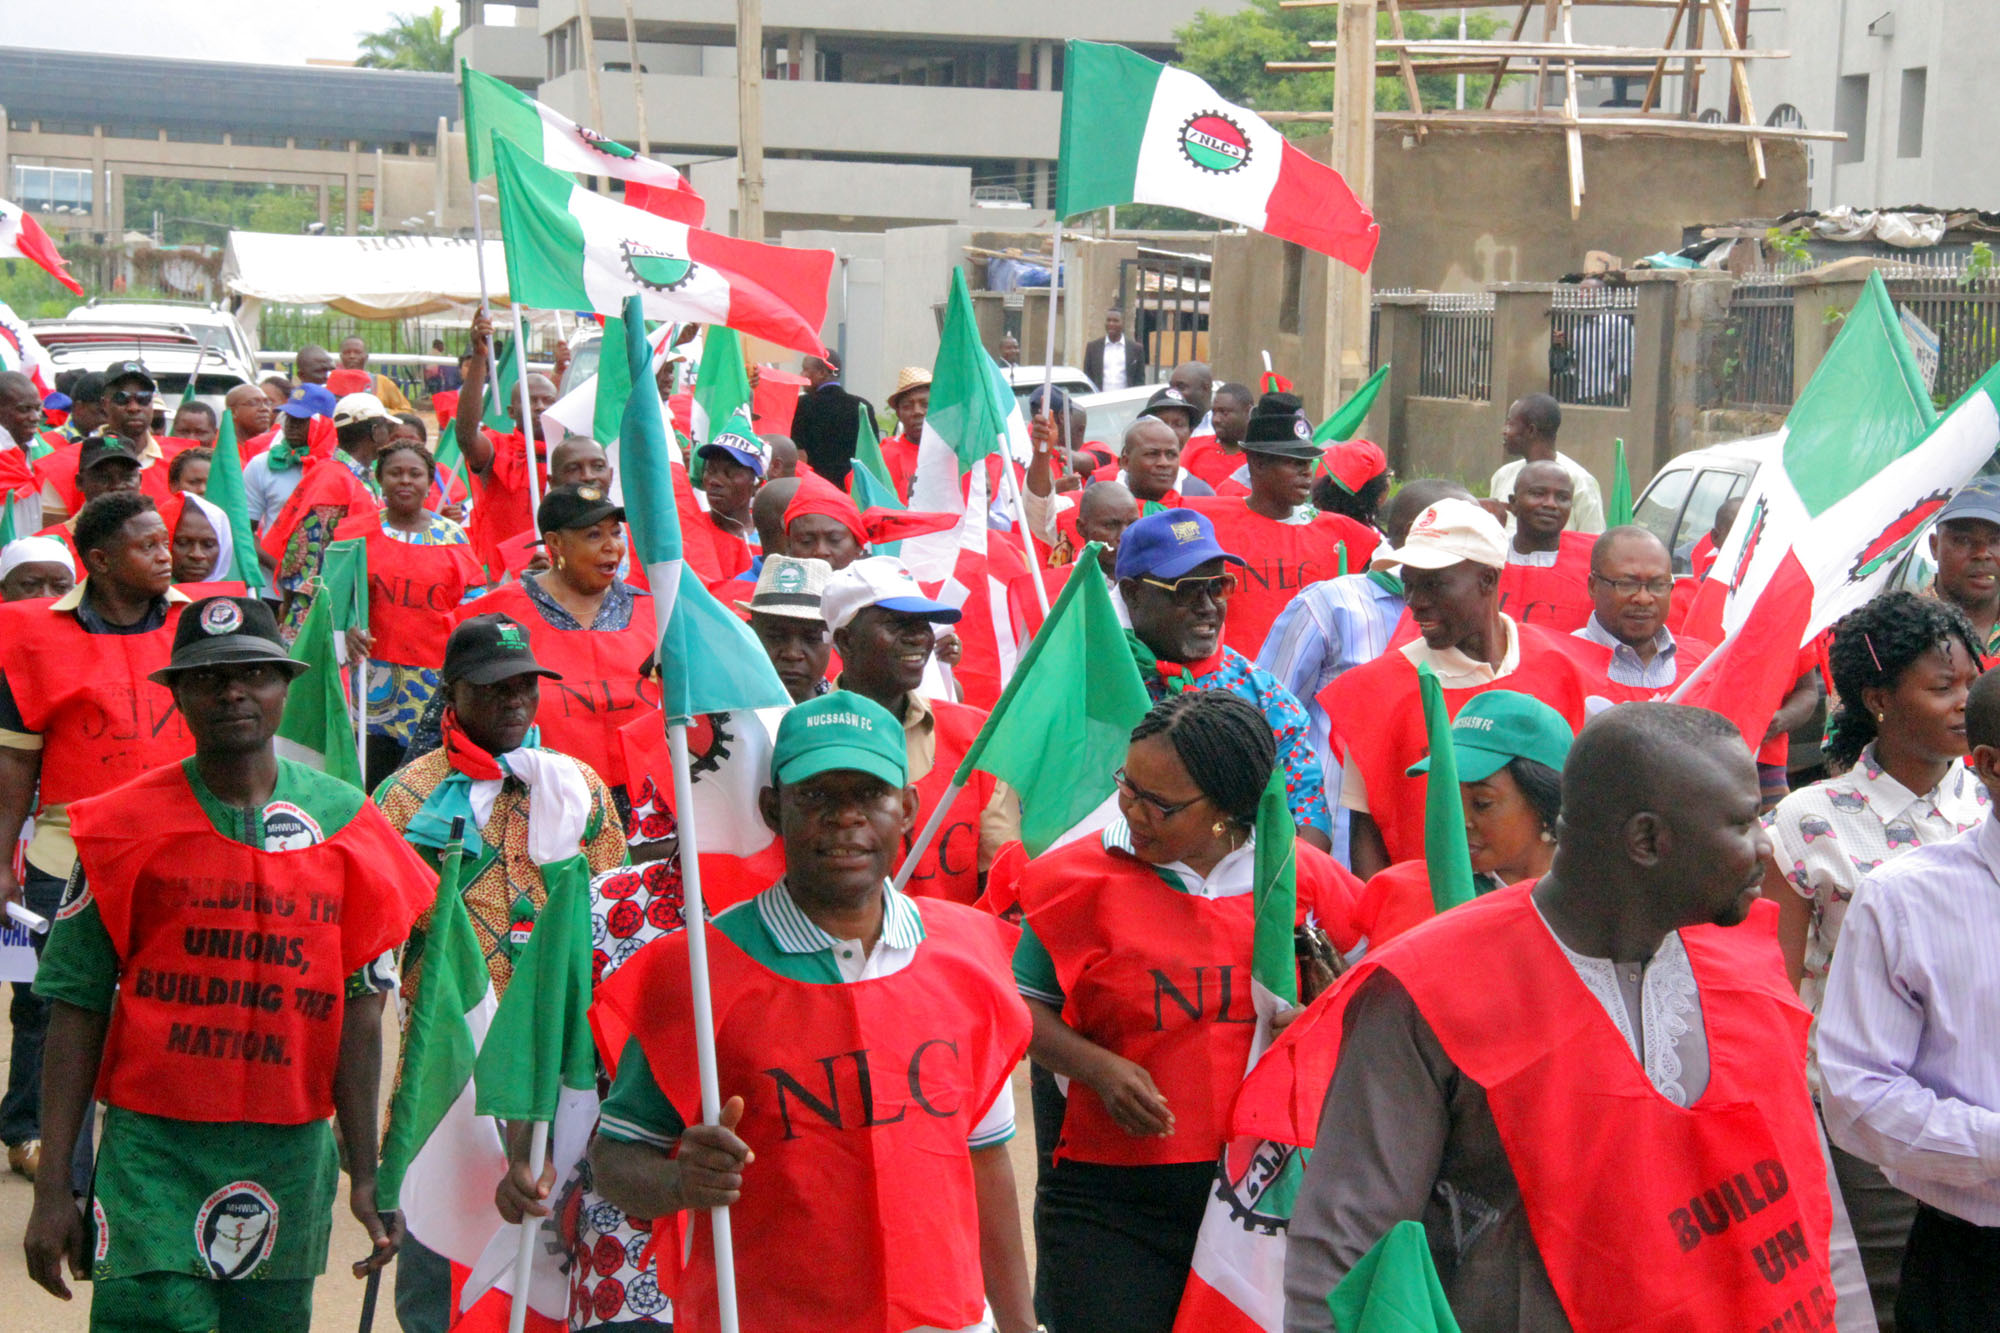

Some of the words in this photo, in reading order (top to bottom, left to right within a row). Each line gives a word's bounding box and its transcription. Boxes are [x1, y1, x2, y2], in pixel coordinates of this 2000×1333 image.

[861, 717, 873, 731] FC
[267, 822, 301, 833] MHWUN
[184, 926, 310, 975] UNIONS,
[135, 968, 284, 1013] BUILDING
[293, 987, 337, 1021] THE
[167, 1022, 292, 1066] NATION.
[762, 1039, 960, 1140] NLC
[226, 1203, 260, 1213] MHWUN
